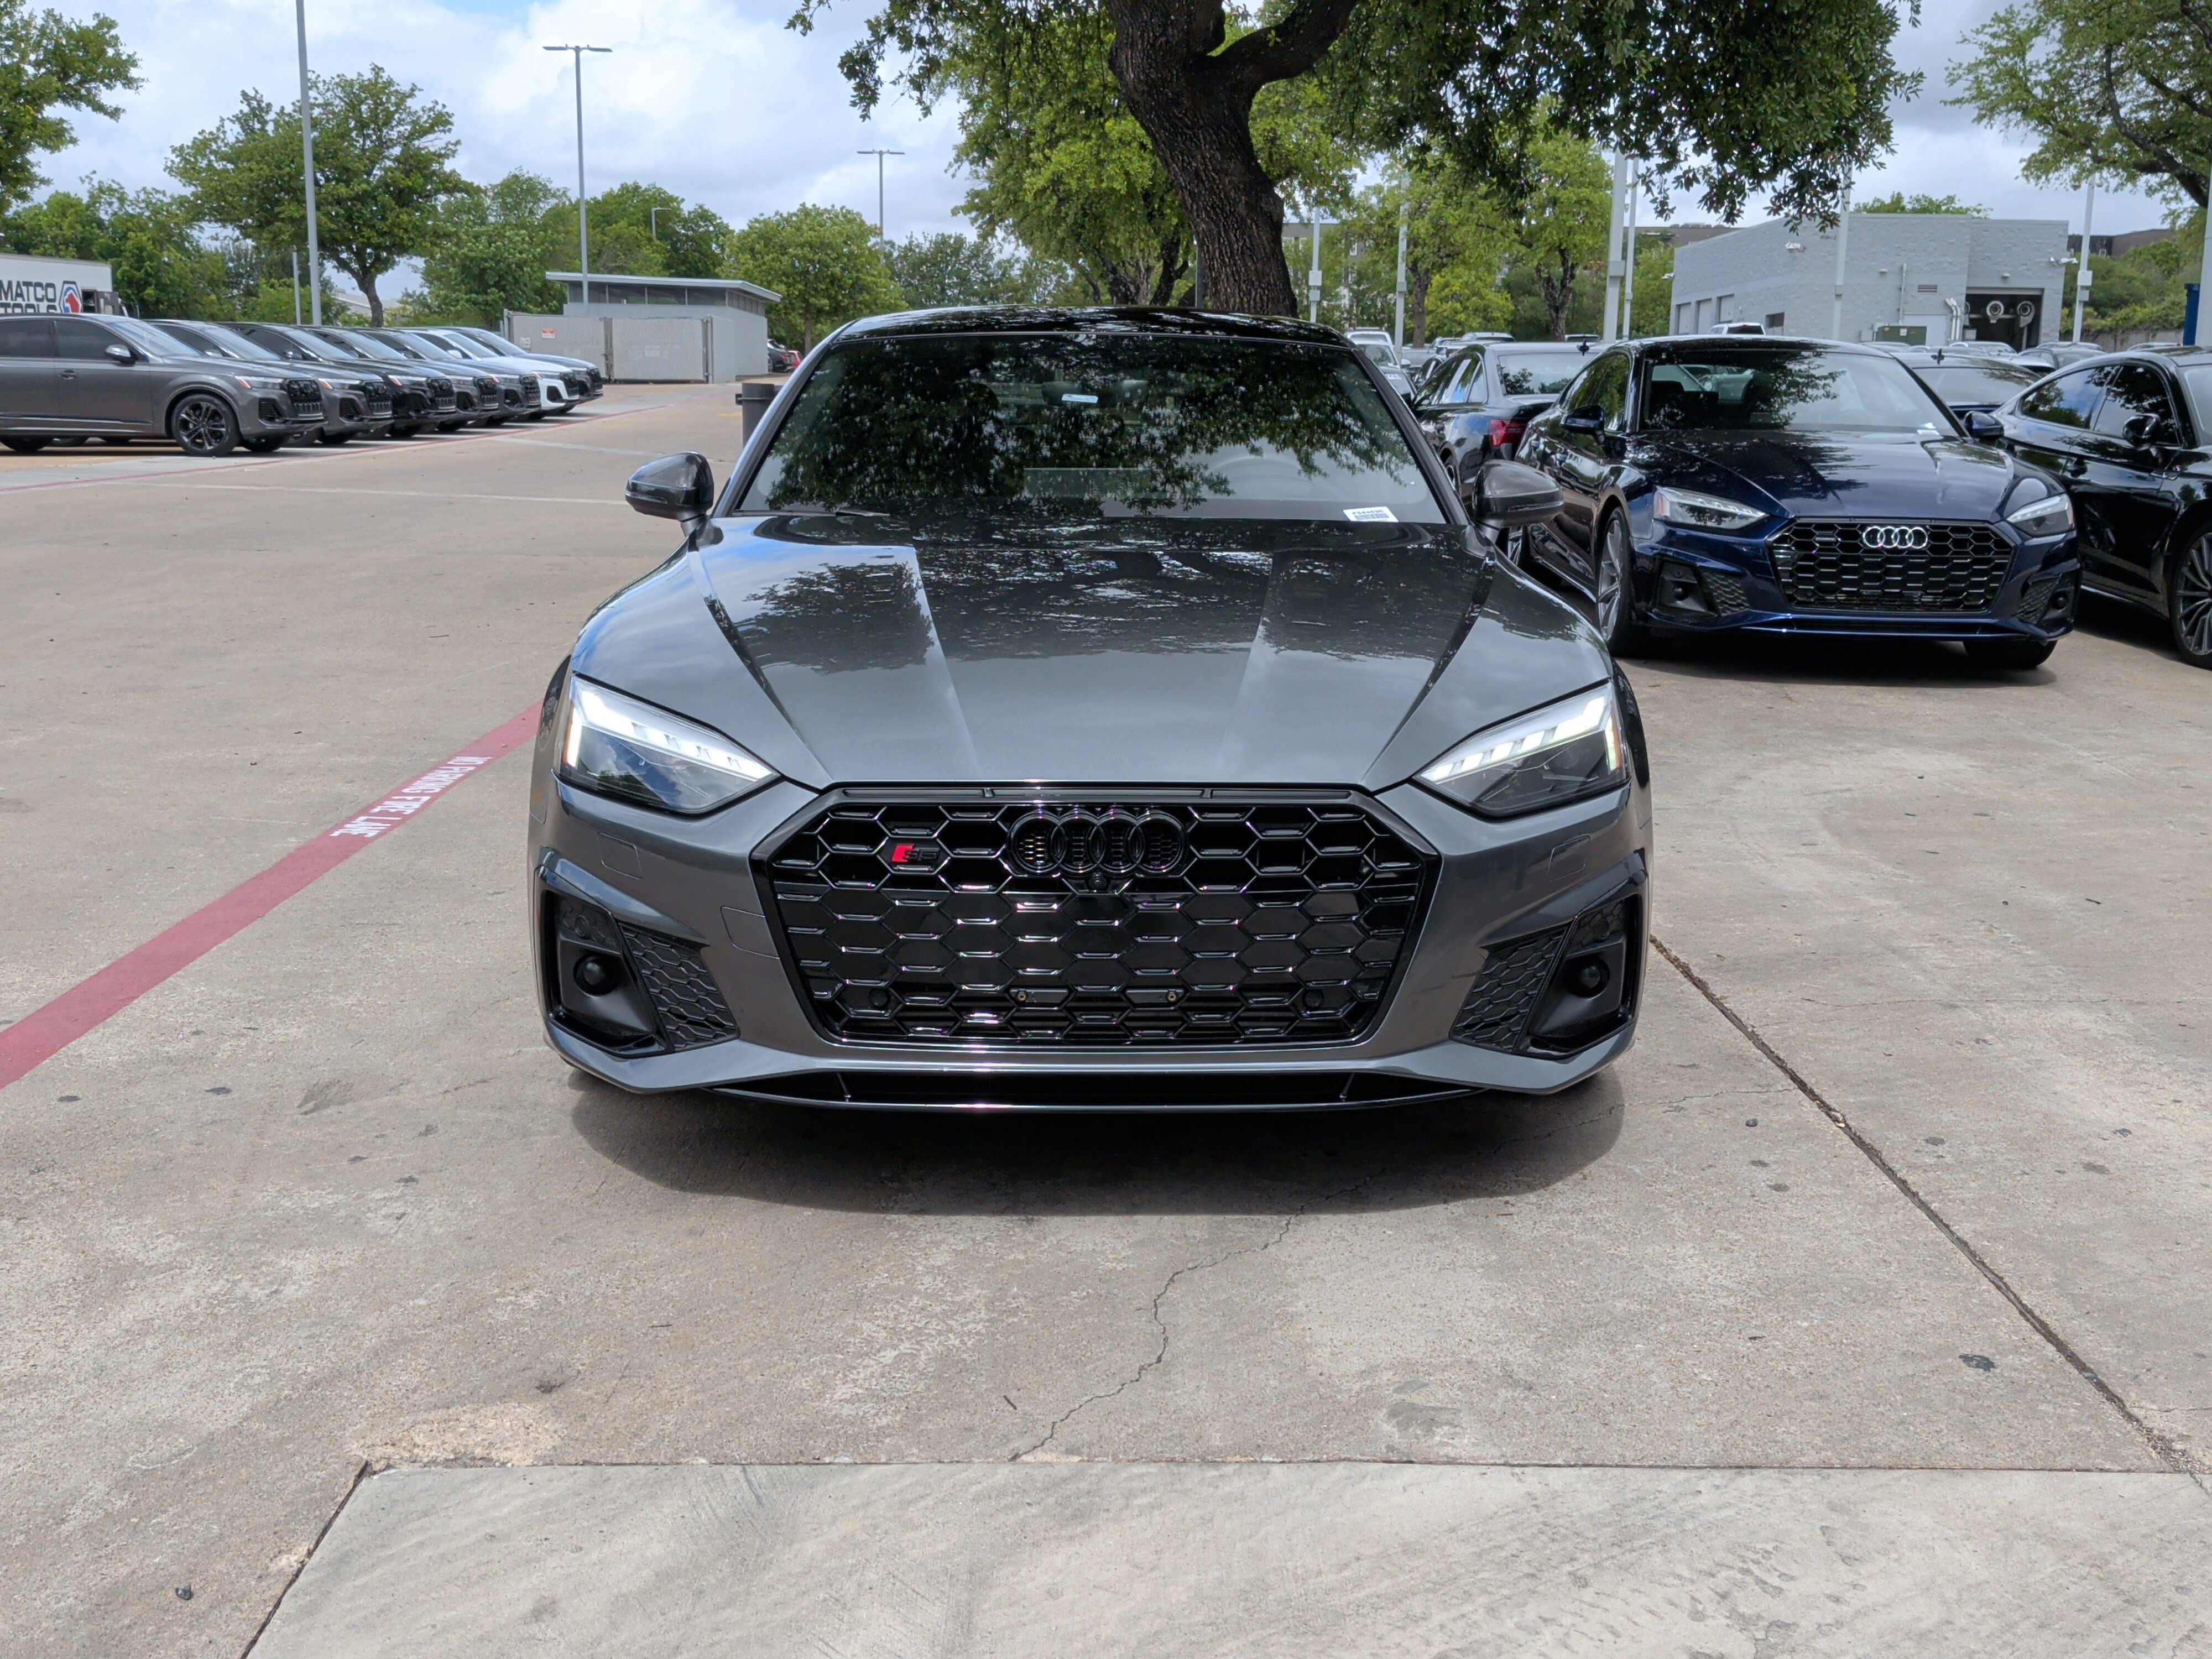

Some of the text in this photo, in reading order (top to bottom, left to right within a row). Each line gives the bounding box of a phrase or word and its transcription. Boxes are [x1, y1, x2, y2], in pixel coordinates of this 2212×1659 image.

[0, 280, 56, 302] MATCO
[401, 766, 476, 793] PARKING
[369, 796, 431, 815] FIRE
[330, 816, 402, 838] LANE
